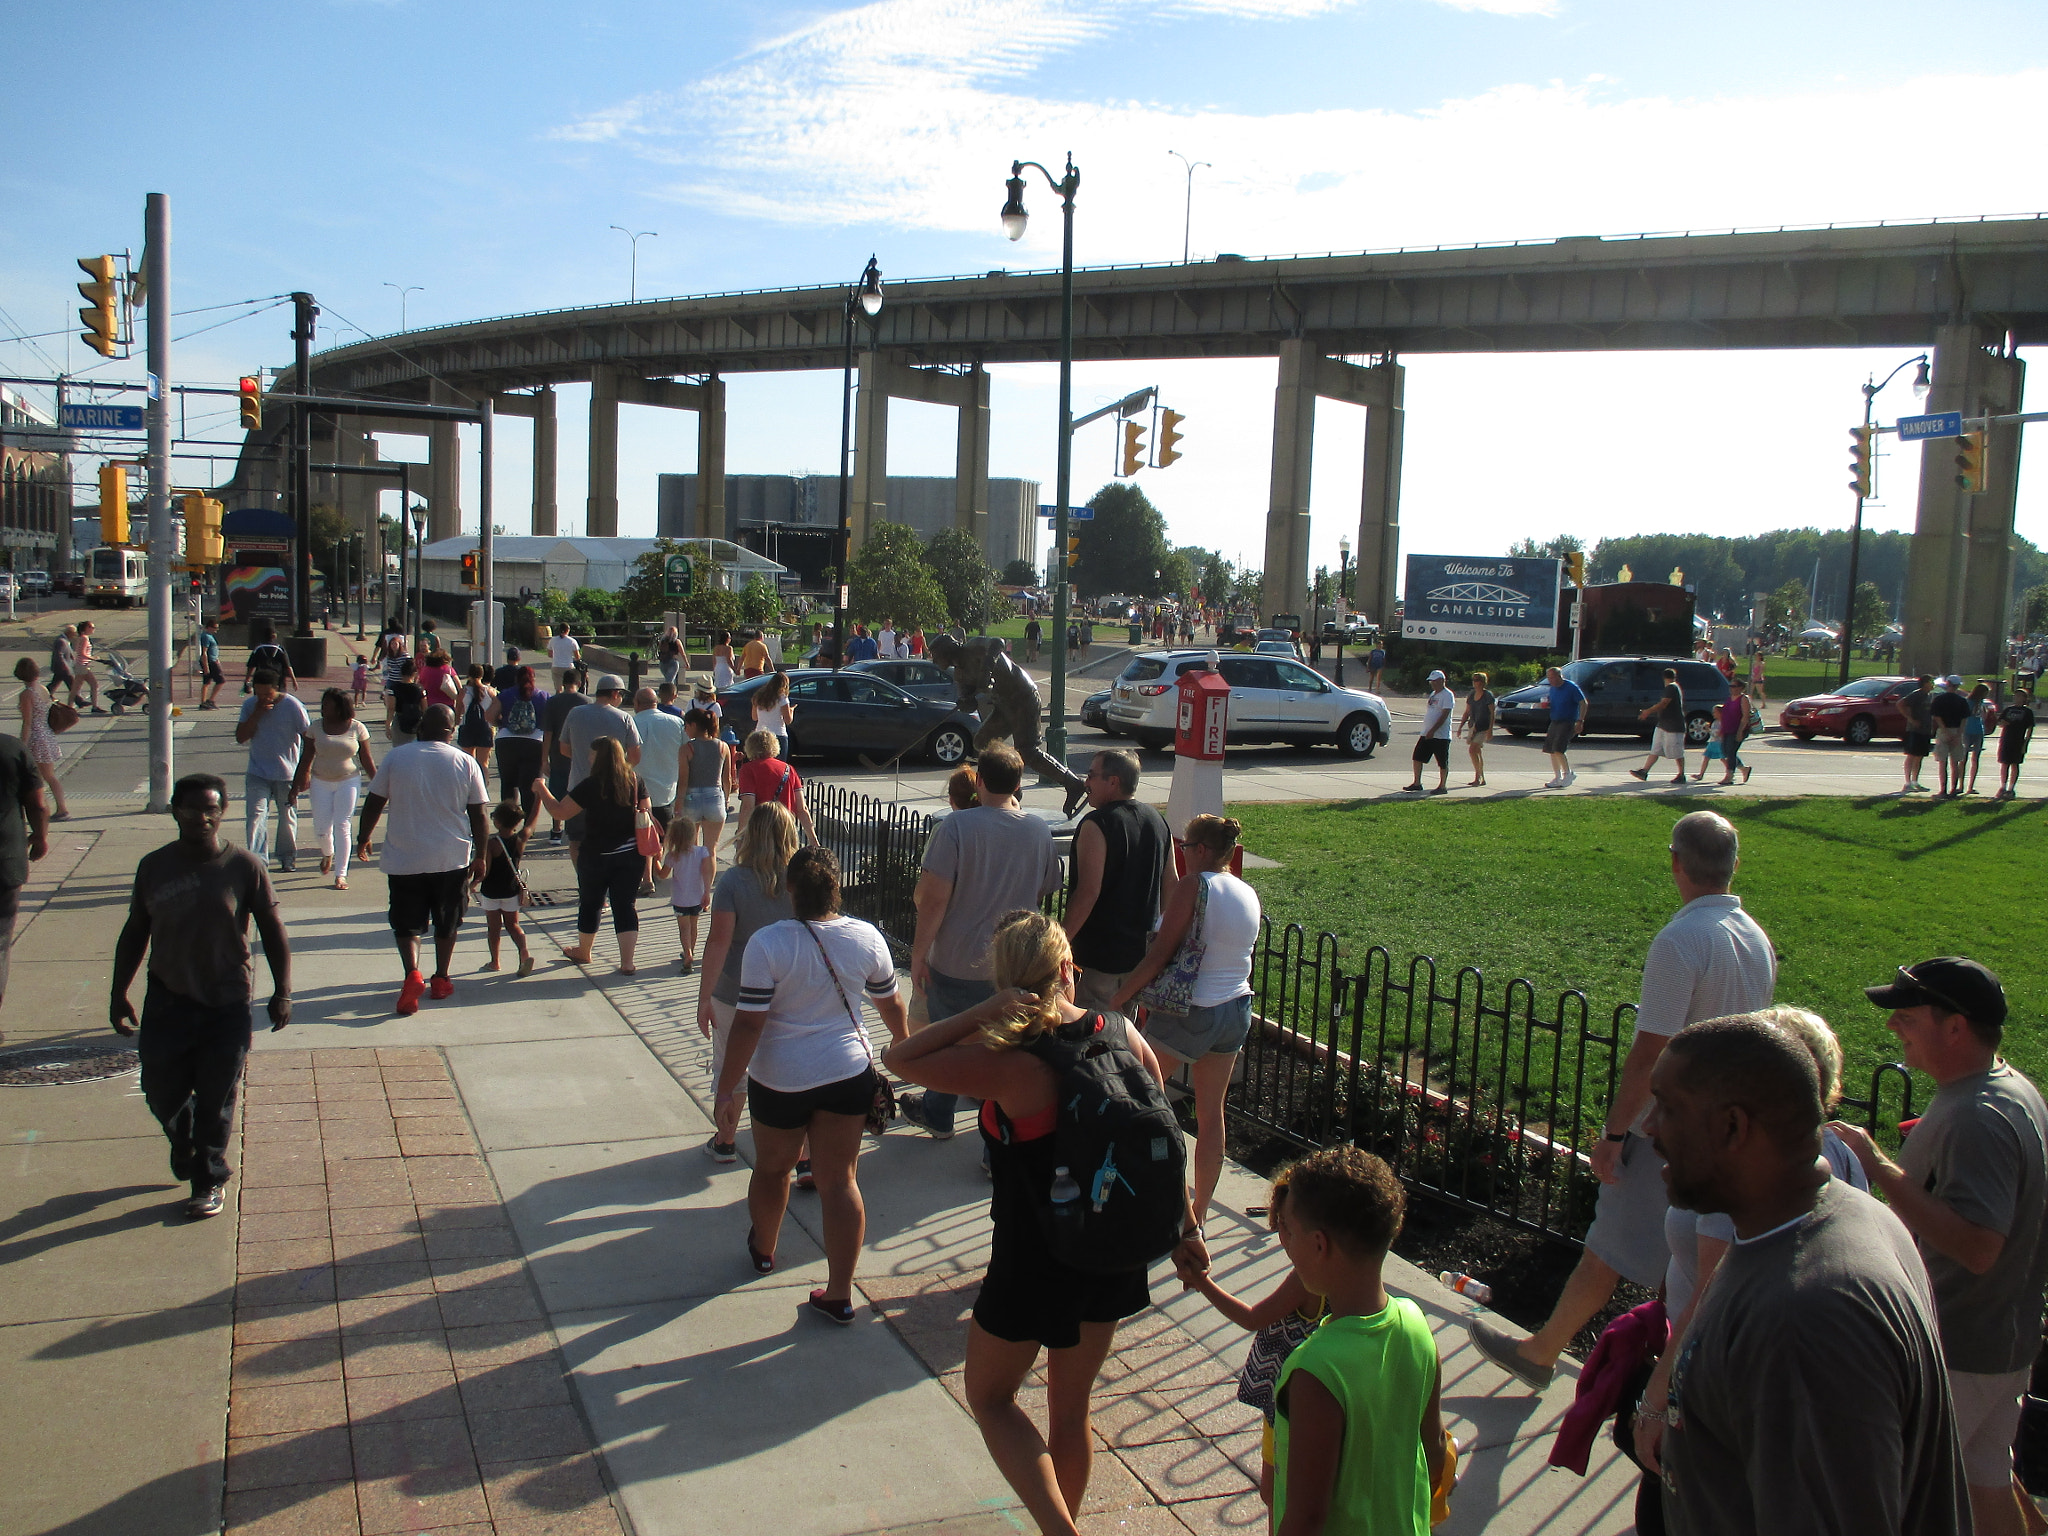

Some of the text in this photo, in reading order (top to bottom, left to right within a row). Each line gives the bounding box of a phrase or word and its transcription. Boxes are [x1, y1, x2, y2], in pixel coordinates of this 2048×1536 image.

[63, 408, 125, 427] MARINE
[1902, 419, 1945, 436] HANOVER
[1047, 506, 1078, 517] MANE
[1444, 562, 1516, 577] Welcome To
[273, 585, 289, 594] Prep
[1430, 603, 1526, 618] CANALSIDE
[1183, 688, 1195, 698] FIRE
[1208, 697, 1220, 753] FIRE
